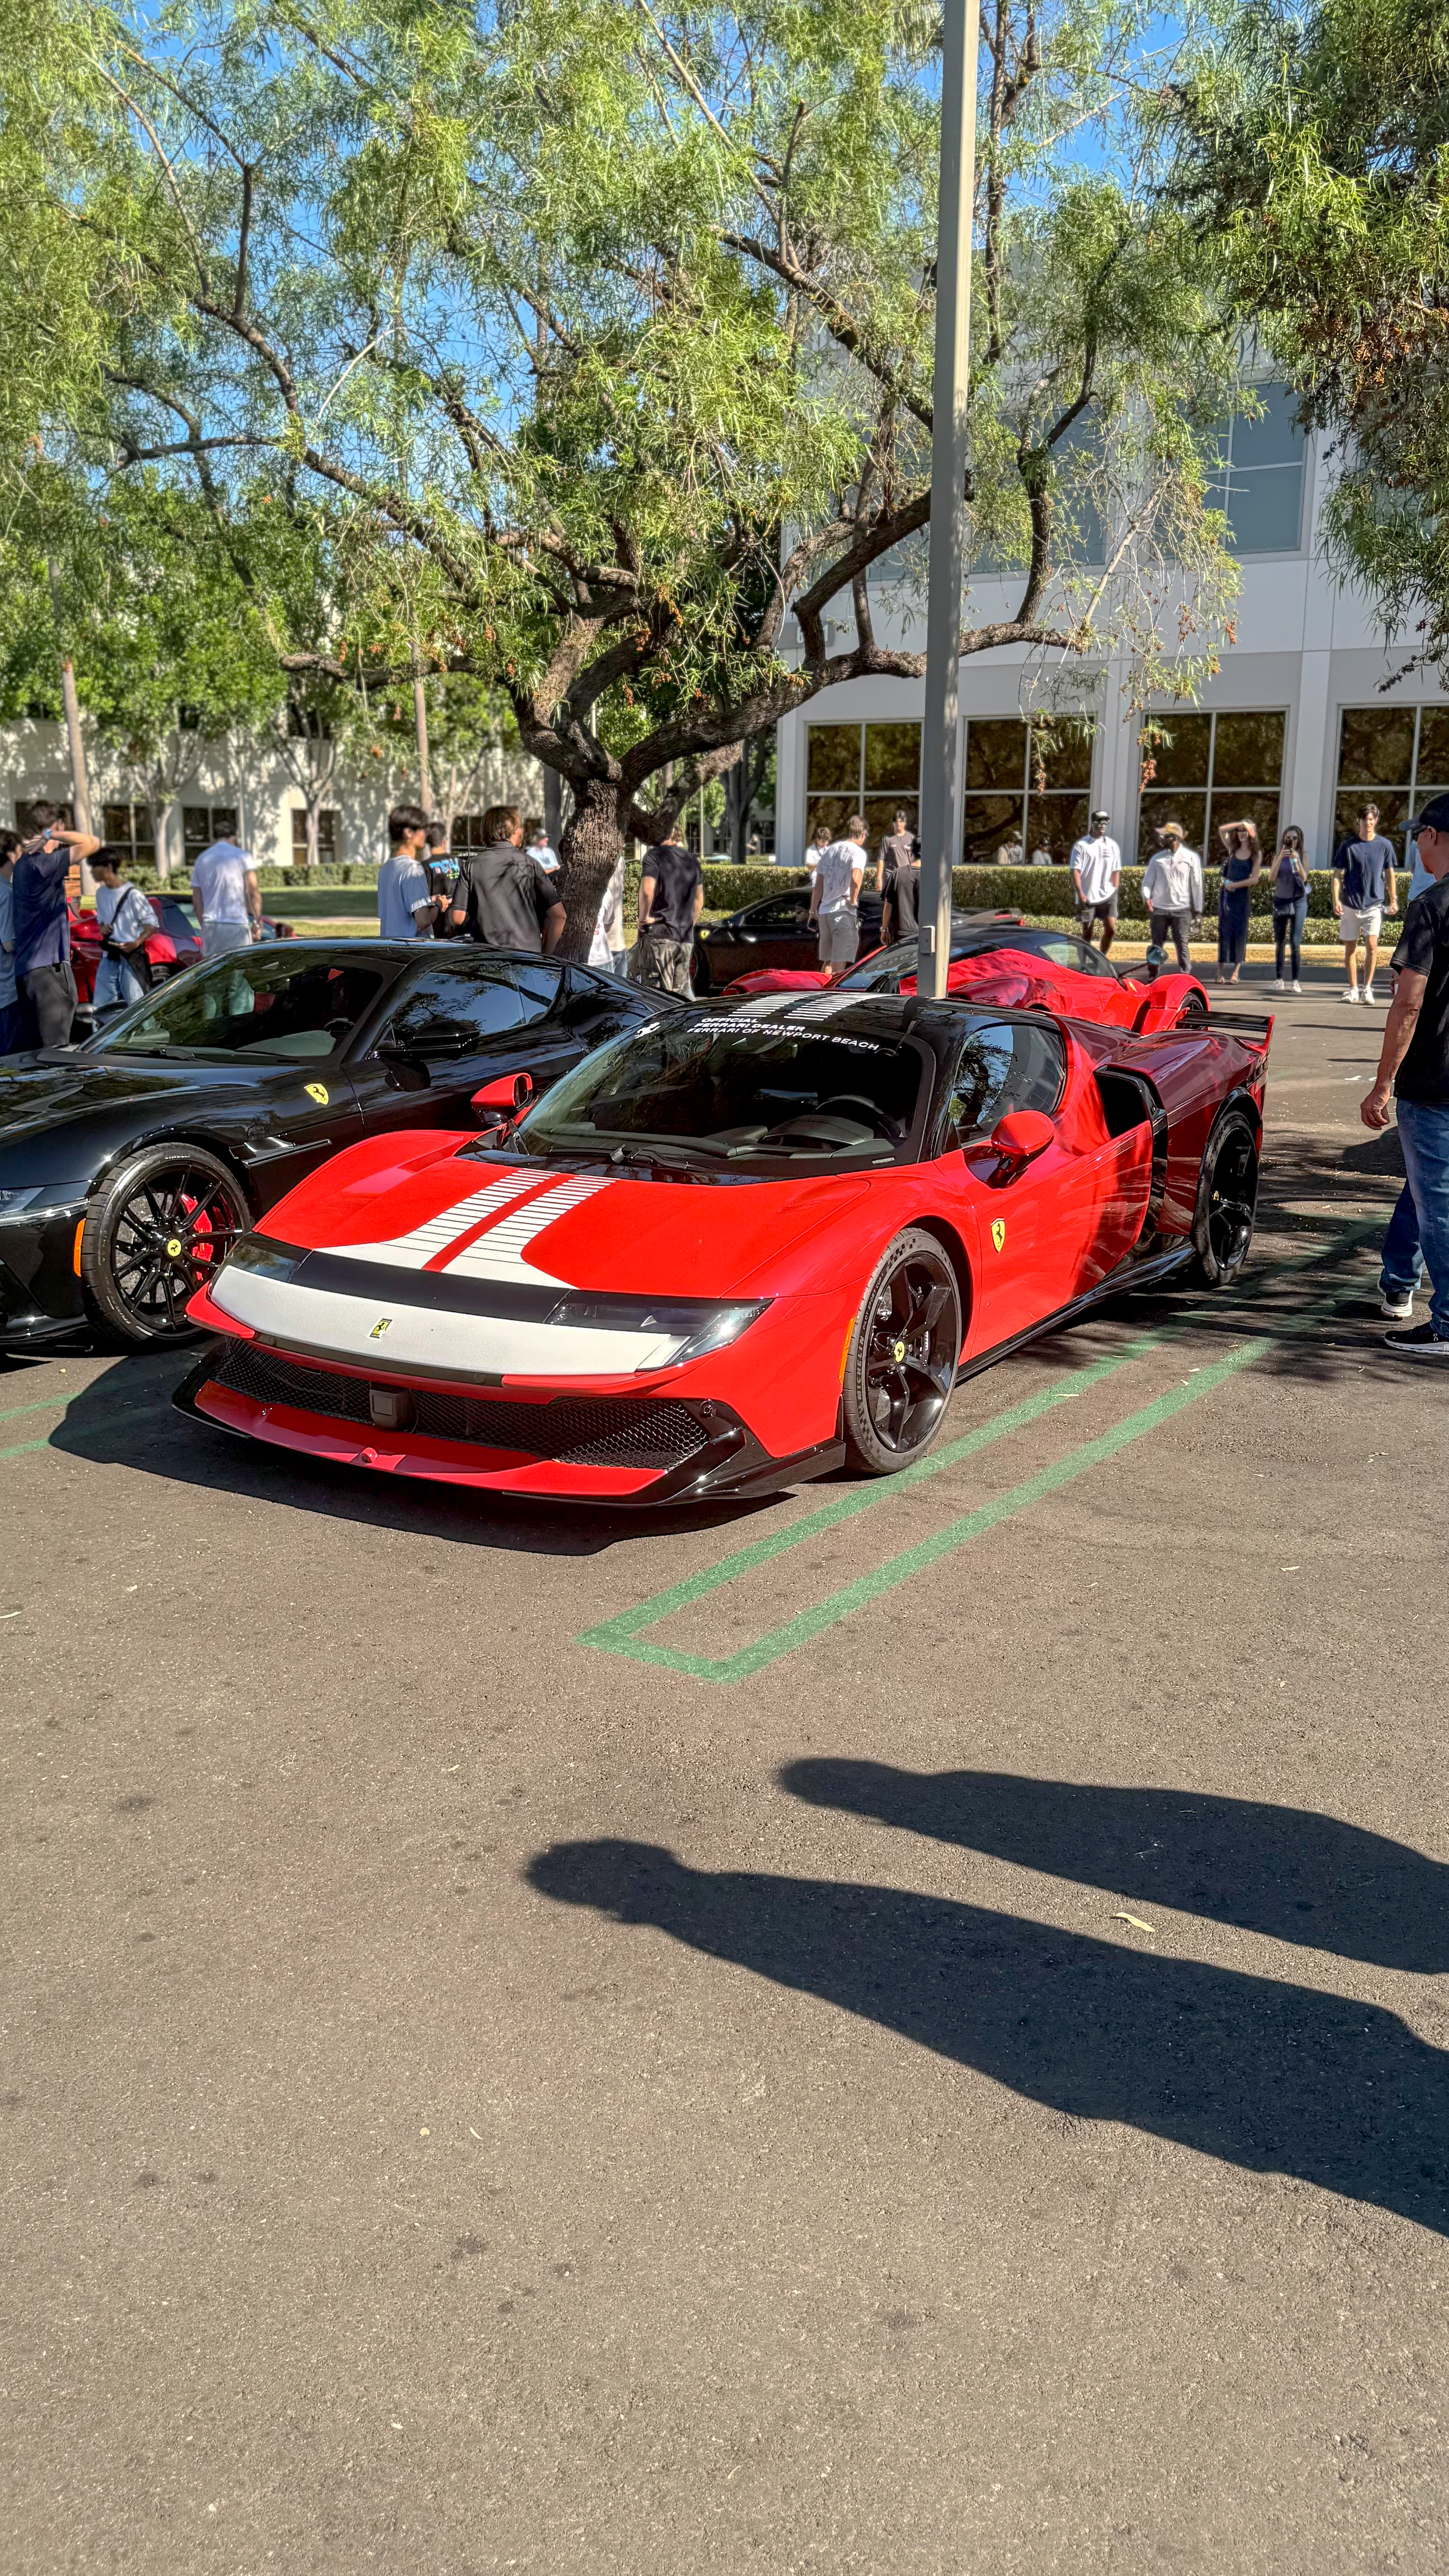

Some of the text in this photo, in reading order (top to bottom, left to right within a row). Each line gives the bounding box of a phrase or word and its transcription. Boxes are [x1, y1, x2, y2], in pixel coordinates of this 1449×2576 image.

[762, 1029, 830, 1041] NEWPORT
[831, 1036, 880, 1051] BEACH
[856, 1335, 864, 1400] MICHELIN
[867, 1289, 877, 1310] SPORT
